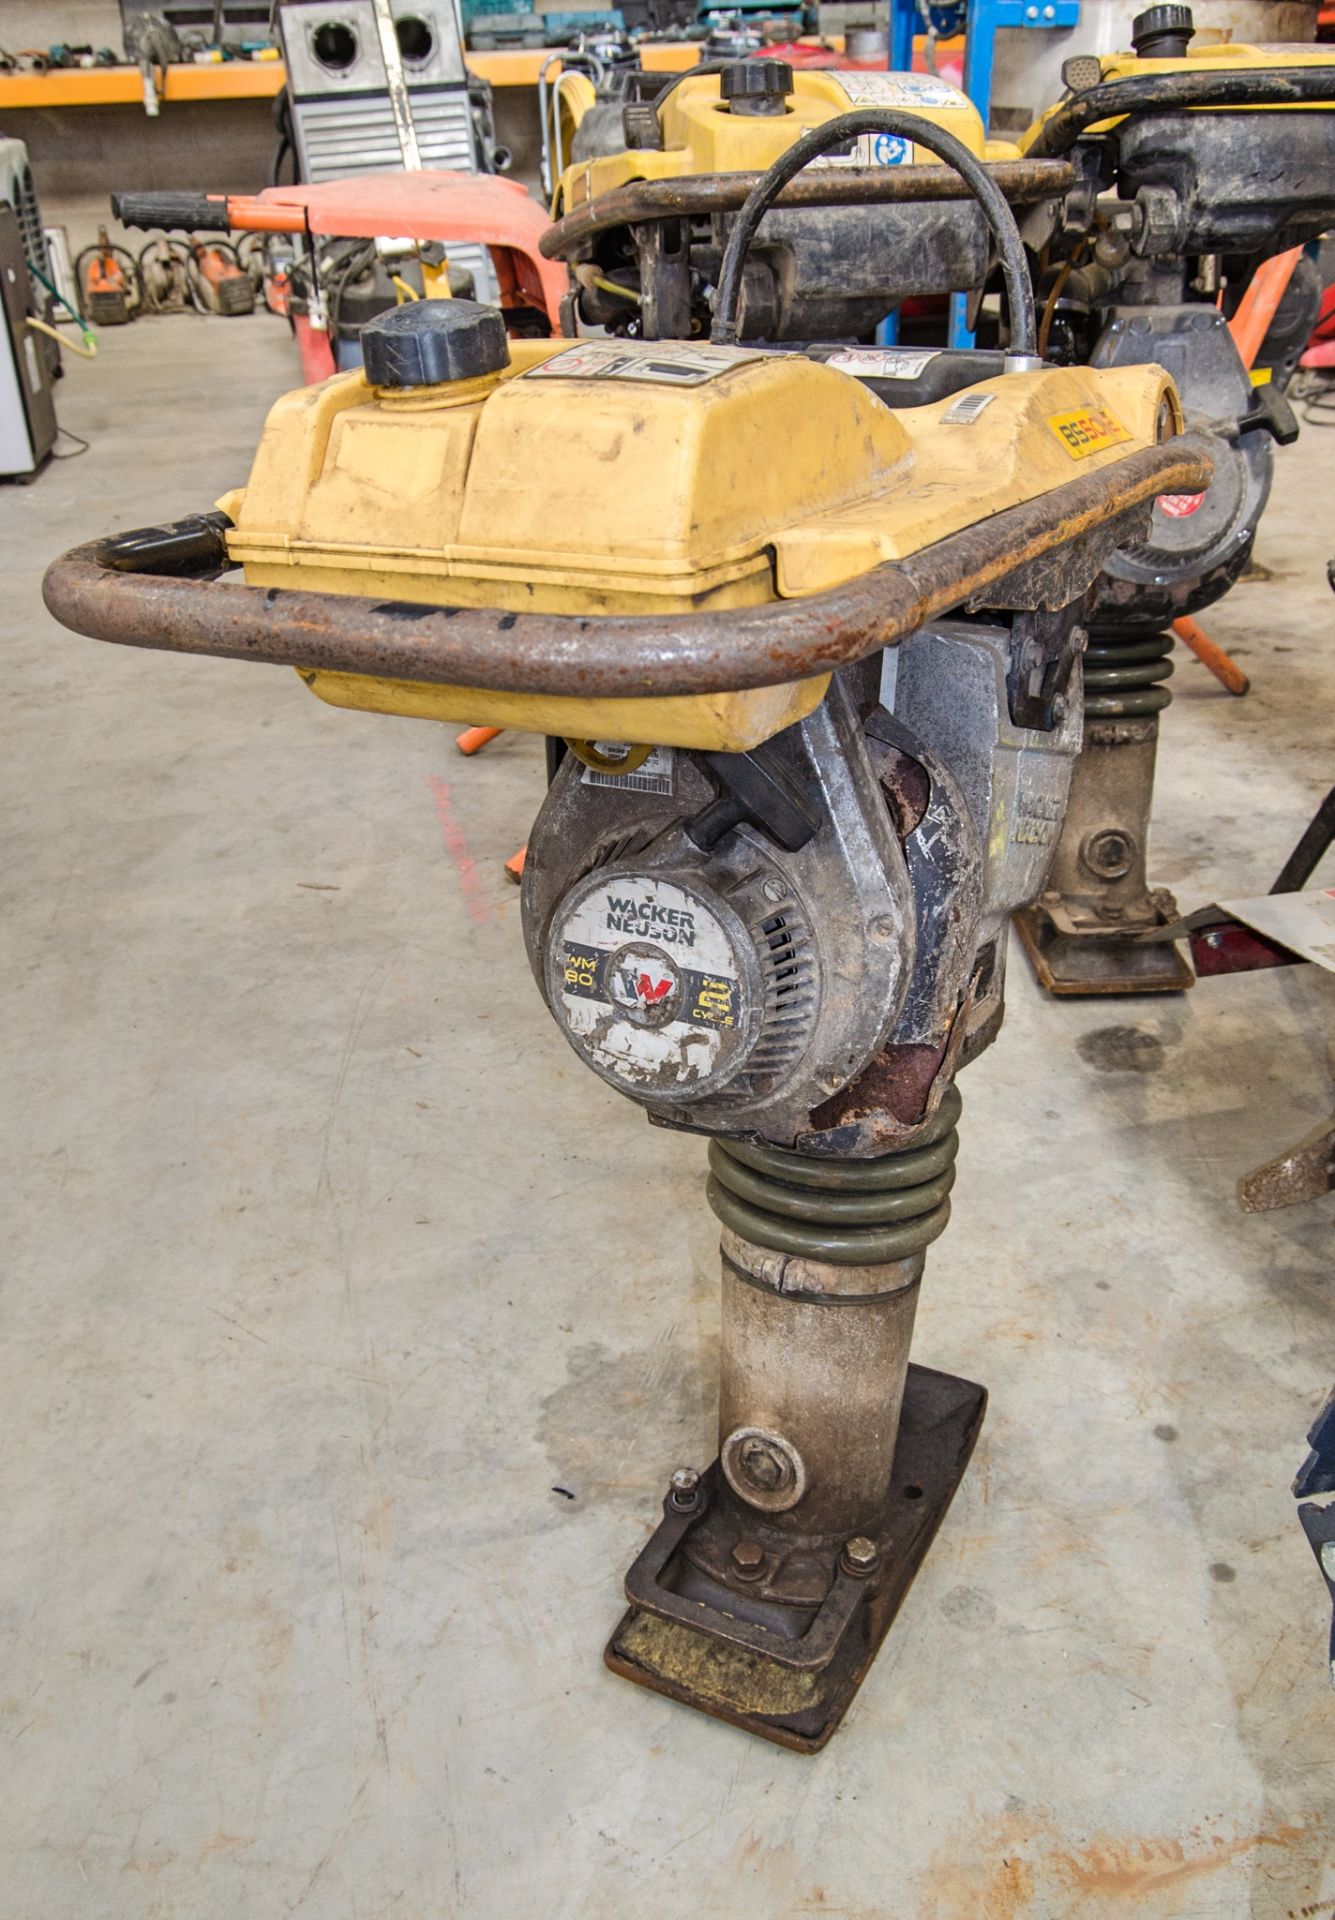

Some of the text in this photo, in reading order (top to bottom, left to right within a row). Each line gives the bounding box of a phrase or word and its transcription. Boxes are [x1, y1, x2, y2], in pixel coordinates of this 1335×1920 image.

[607, 895, 695, 930] WACKER
[606, 913, 695, 946] NEUSON
[564, 969, 594, 986] 80
[566, 956, 597, 973] WM
[698, 979, 731, 1013] 2
